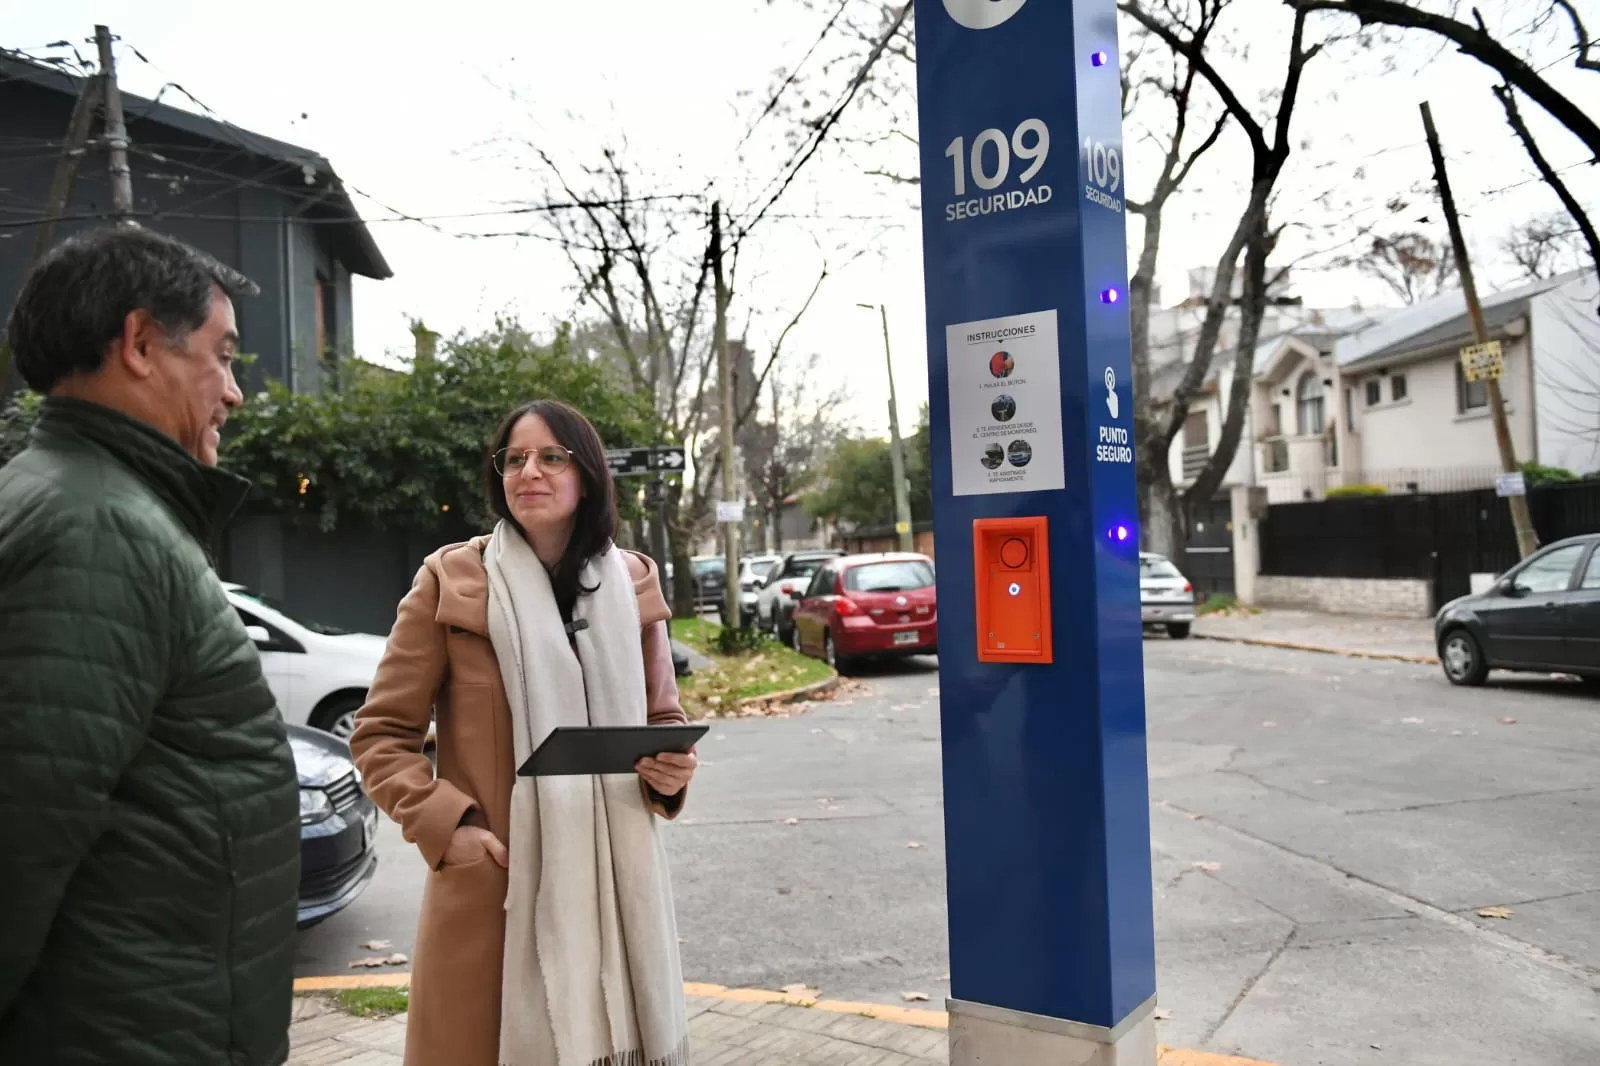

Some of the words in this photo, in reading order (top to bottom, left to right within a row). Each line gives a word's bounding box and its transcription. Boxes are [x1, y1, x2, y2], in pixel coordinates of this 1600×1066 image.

[945, 118, 1050, 196] 109
[1084, 136, 1120, 193] 109
[945, 185, 1052, 221] SEGURIDAD
[1085, 184, 1122, 213] SEGURIDAD
[966, 325, 1036, 342] INSTRUCCIONES
[1099, 425, 1128, 445] PUNTO
[1096, 444, 1132, 463] SEGURO
